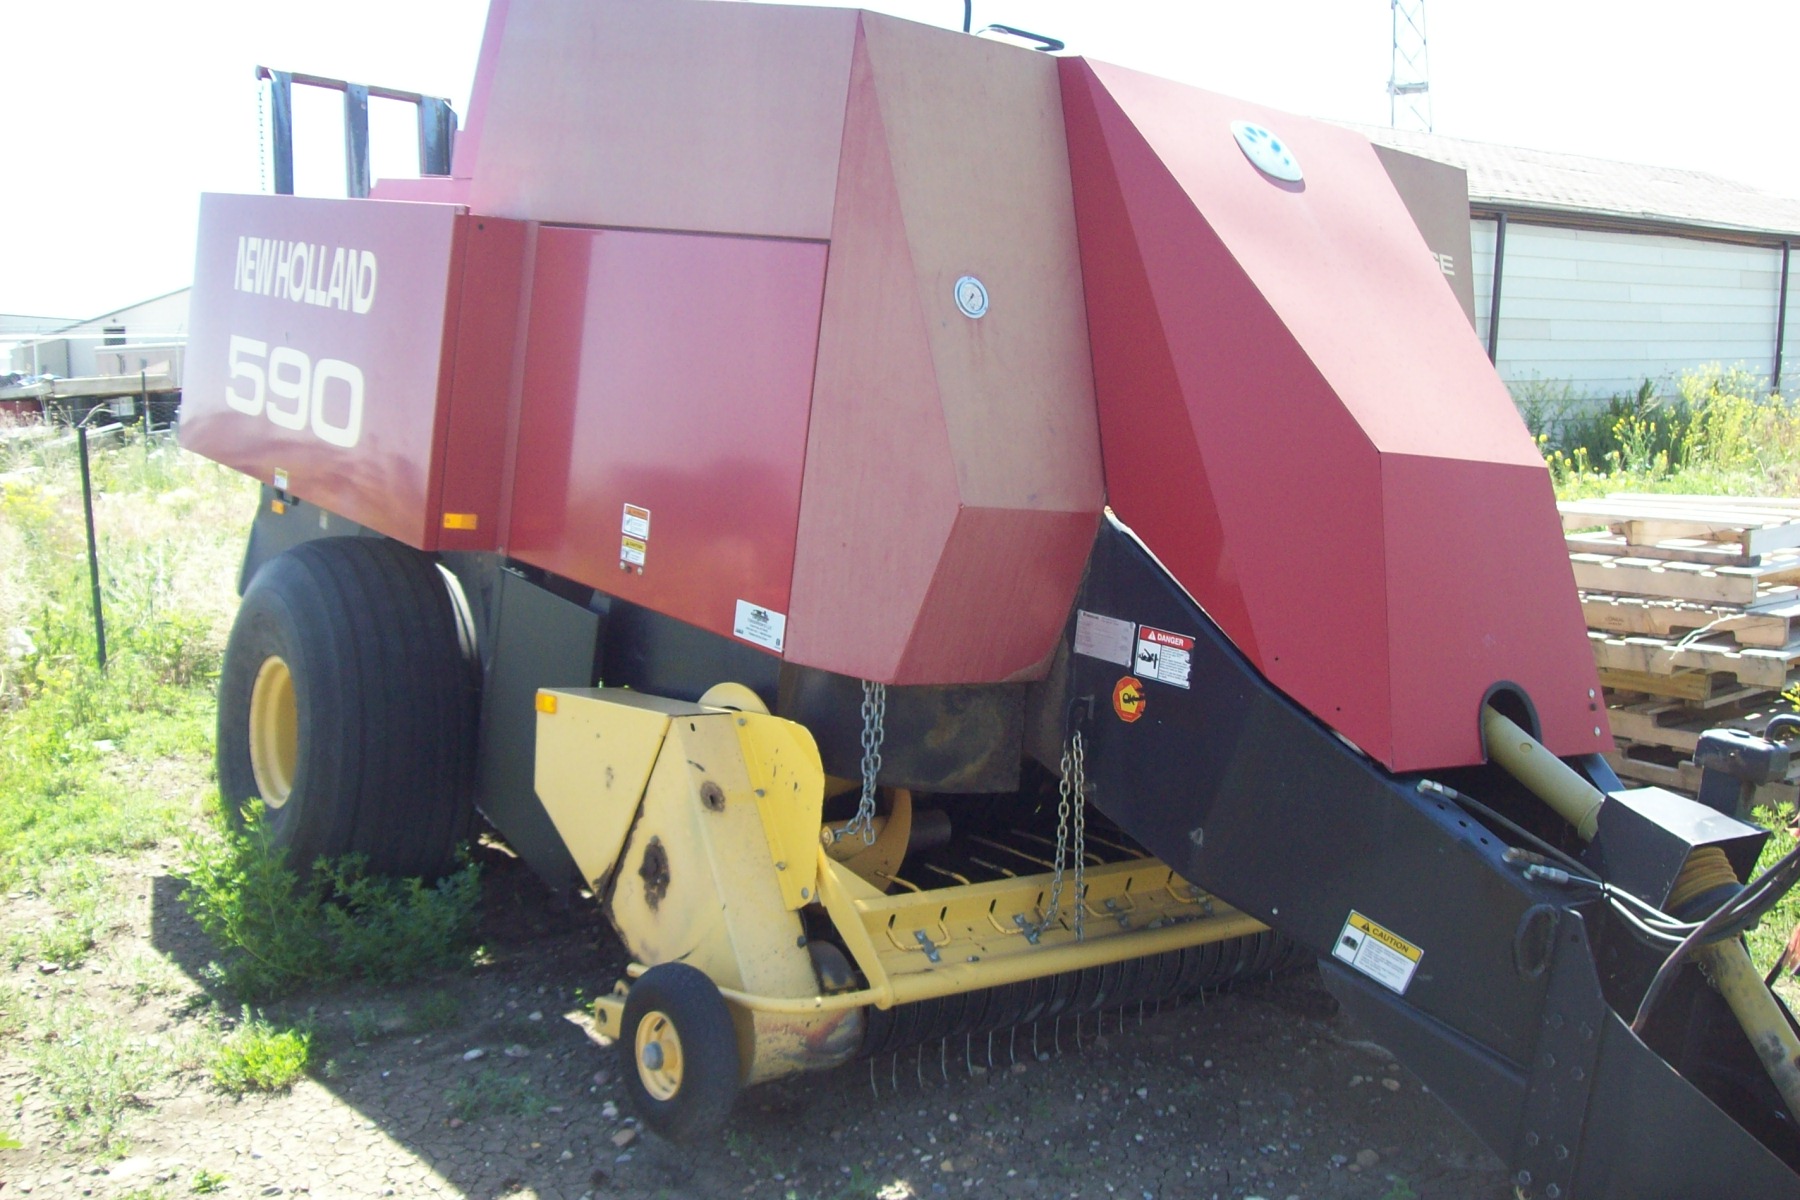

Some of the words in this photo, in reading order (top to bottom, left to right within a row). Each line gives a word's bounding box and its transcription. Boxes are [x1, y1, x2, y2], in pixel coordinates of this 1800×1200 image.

[234, 236, 277, 295] NEW
[274, 241, 377, 314] HOLLAND
[225, 334, 364, 448] 590
[1157, 633, 1184, 646] DANGER
[1372, 927, 1409, 953] CAUTION
